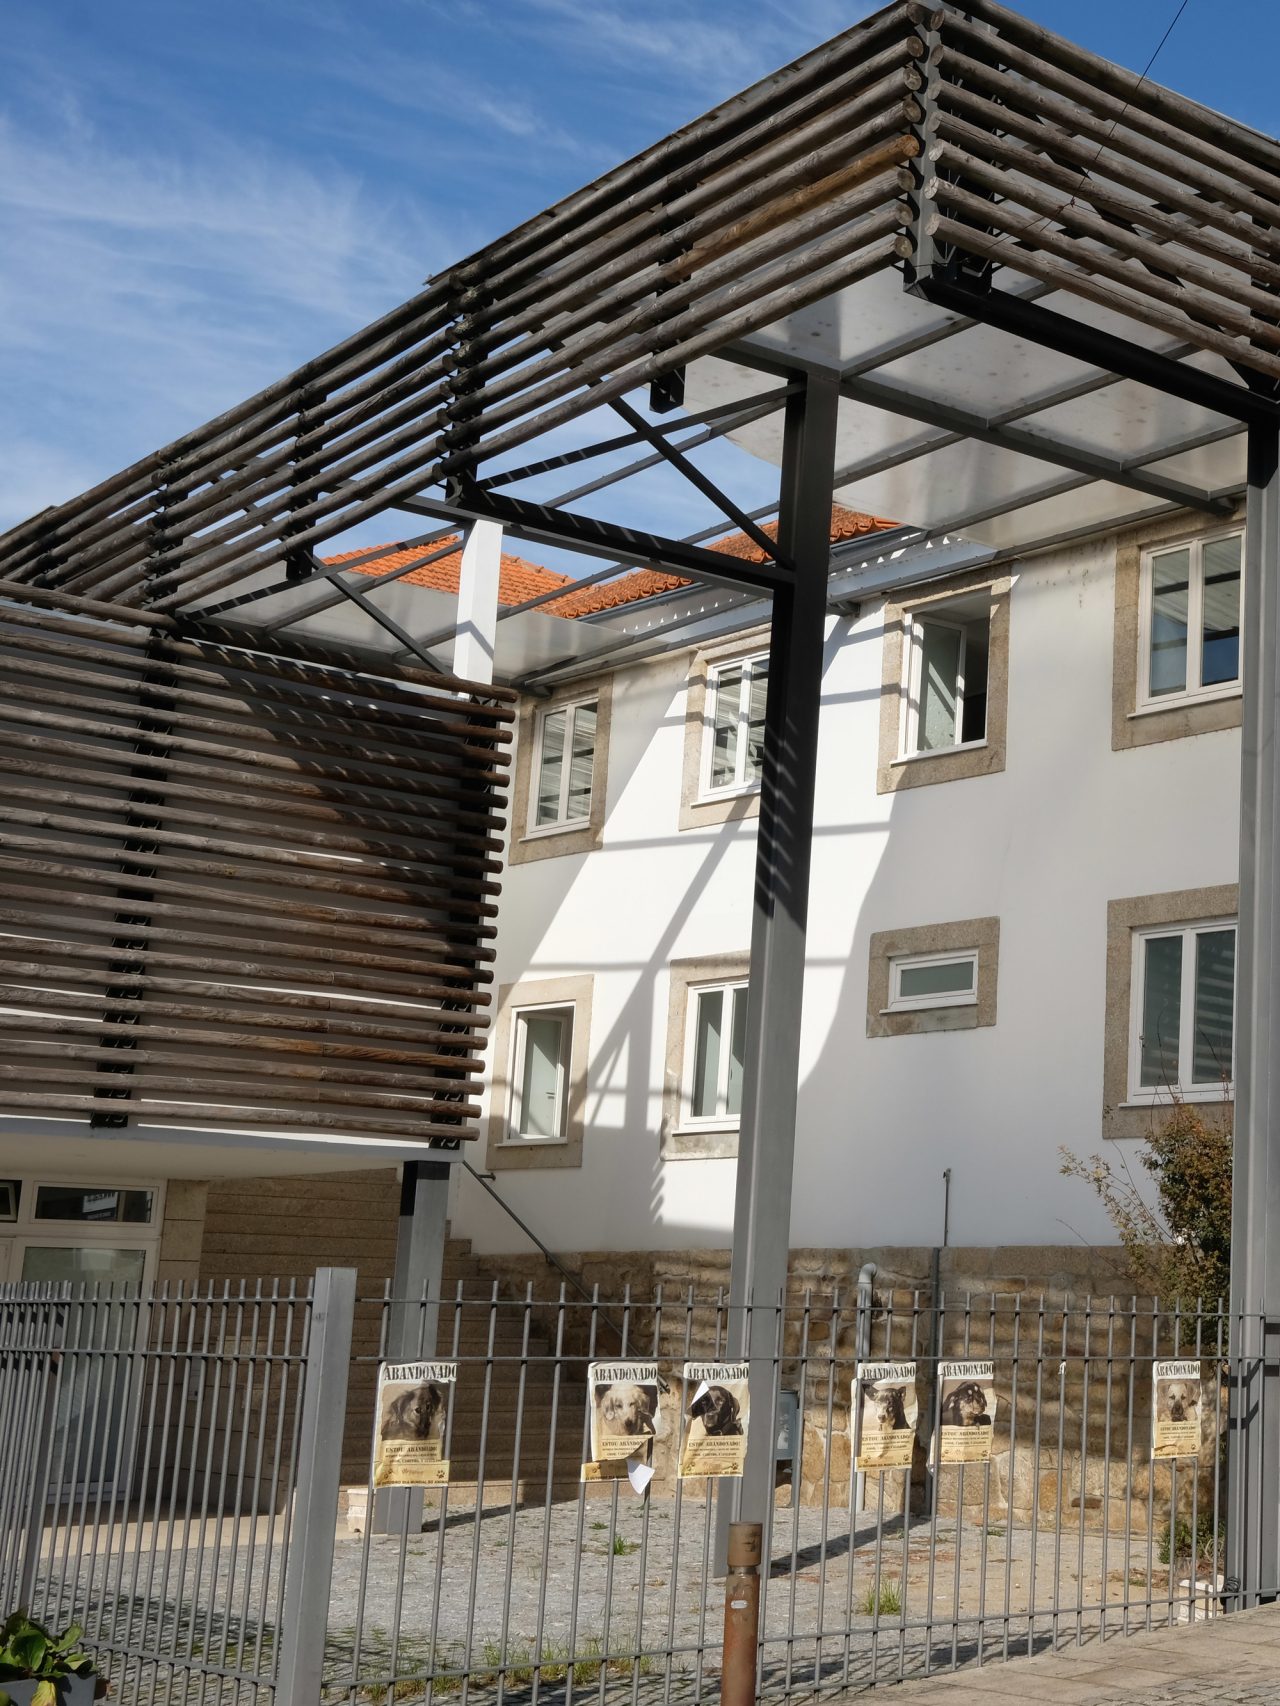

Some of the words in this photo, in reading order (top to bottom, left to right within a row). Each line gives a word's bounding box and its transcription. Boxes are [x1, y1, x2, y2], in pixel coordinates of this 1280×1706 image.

[384, 1364, 457, 1381] ABANDONADO
[594, 1367, 657, 1382] ABANDONADO
[688, 1366, 749, 1381] ABANDONADO
[862, 1366, 915, 1380] ABANDONADO
[943, 1363, 993, 1377] ABANDONADO
[1157, 1363, 1200, 1377] ABANDONADO
